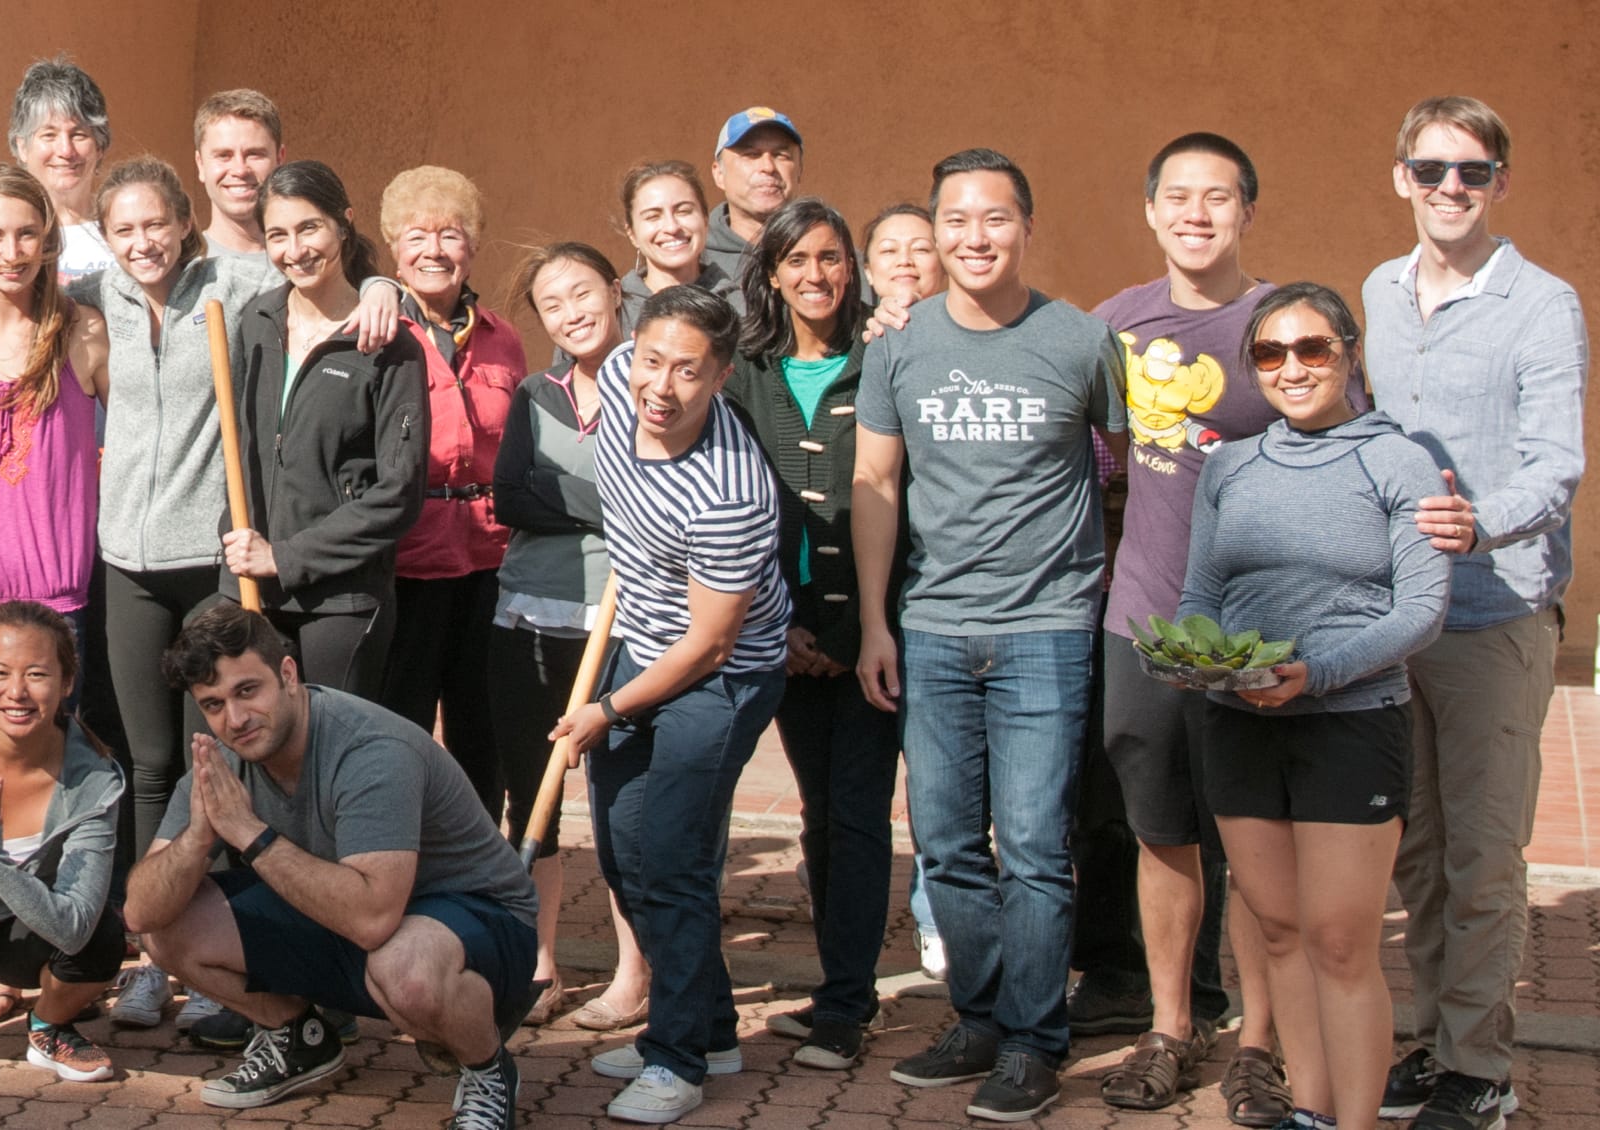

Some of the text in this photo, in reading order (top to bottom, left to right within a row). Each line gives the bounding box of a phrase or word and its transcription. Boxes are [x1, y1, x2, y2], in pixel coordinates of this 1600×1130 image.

[938, 385, 960, 394] SOUR
[993, 383, 1016, 393] BEER
[1016, 386, 1030, 395] CO.
[948, 369, 994, 395] The
[916, 397, 1047, 423] RARE
[932, 423, 1034, 441] BARREL
